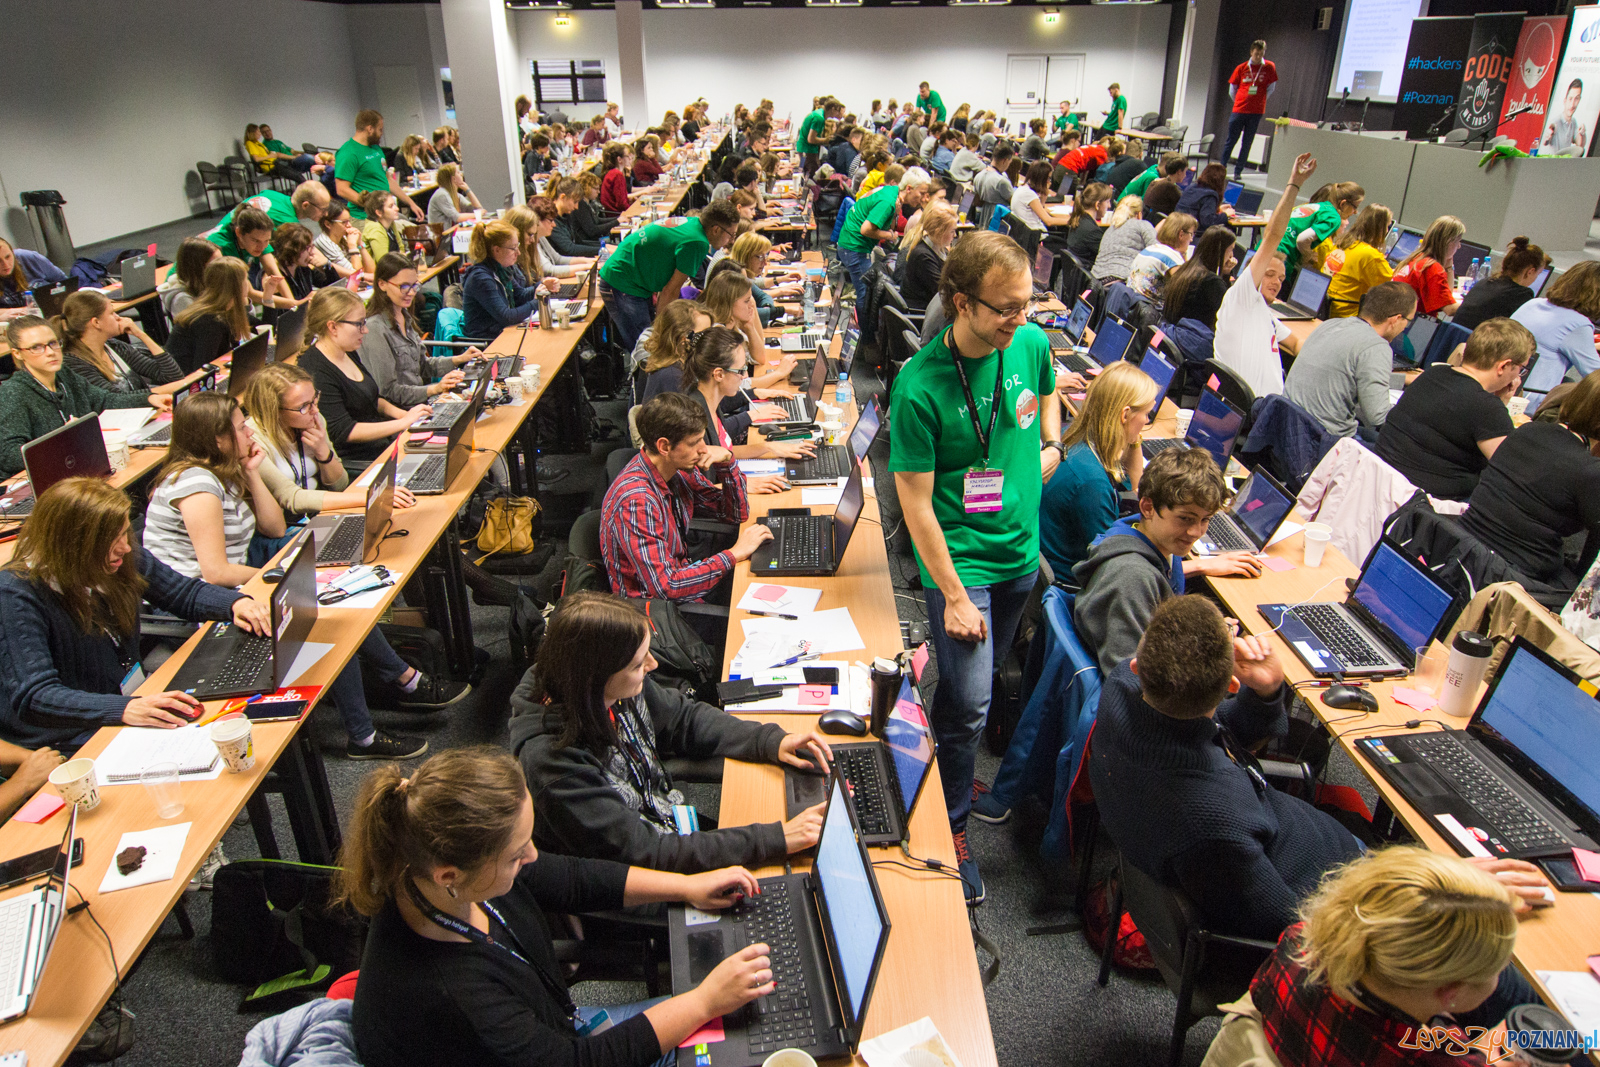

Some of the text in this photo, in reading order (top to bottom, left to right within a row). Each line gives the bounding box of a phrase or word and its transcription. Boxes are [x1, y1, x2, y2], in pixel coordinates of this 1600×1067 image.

[1408, 56, 1463, 70] #hackers
[1464, 54, 1513, 84] CODE
[1402, 91, 1454, 104] #Poznan
[957, 374, 1022, 419] MENOR
[434, 913, 469, 933] django hotspot
